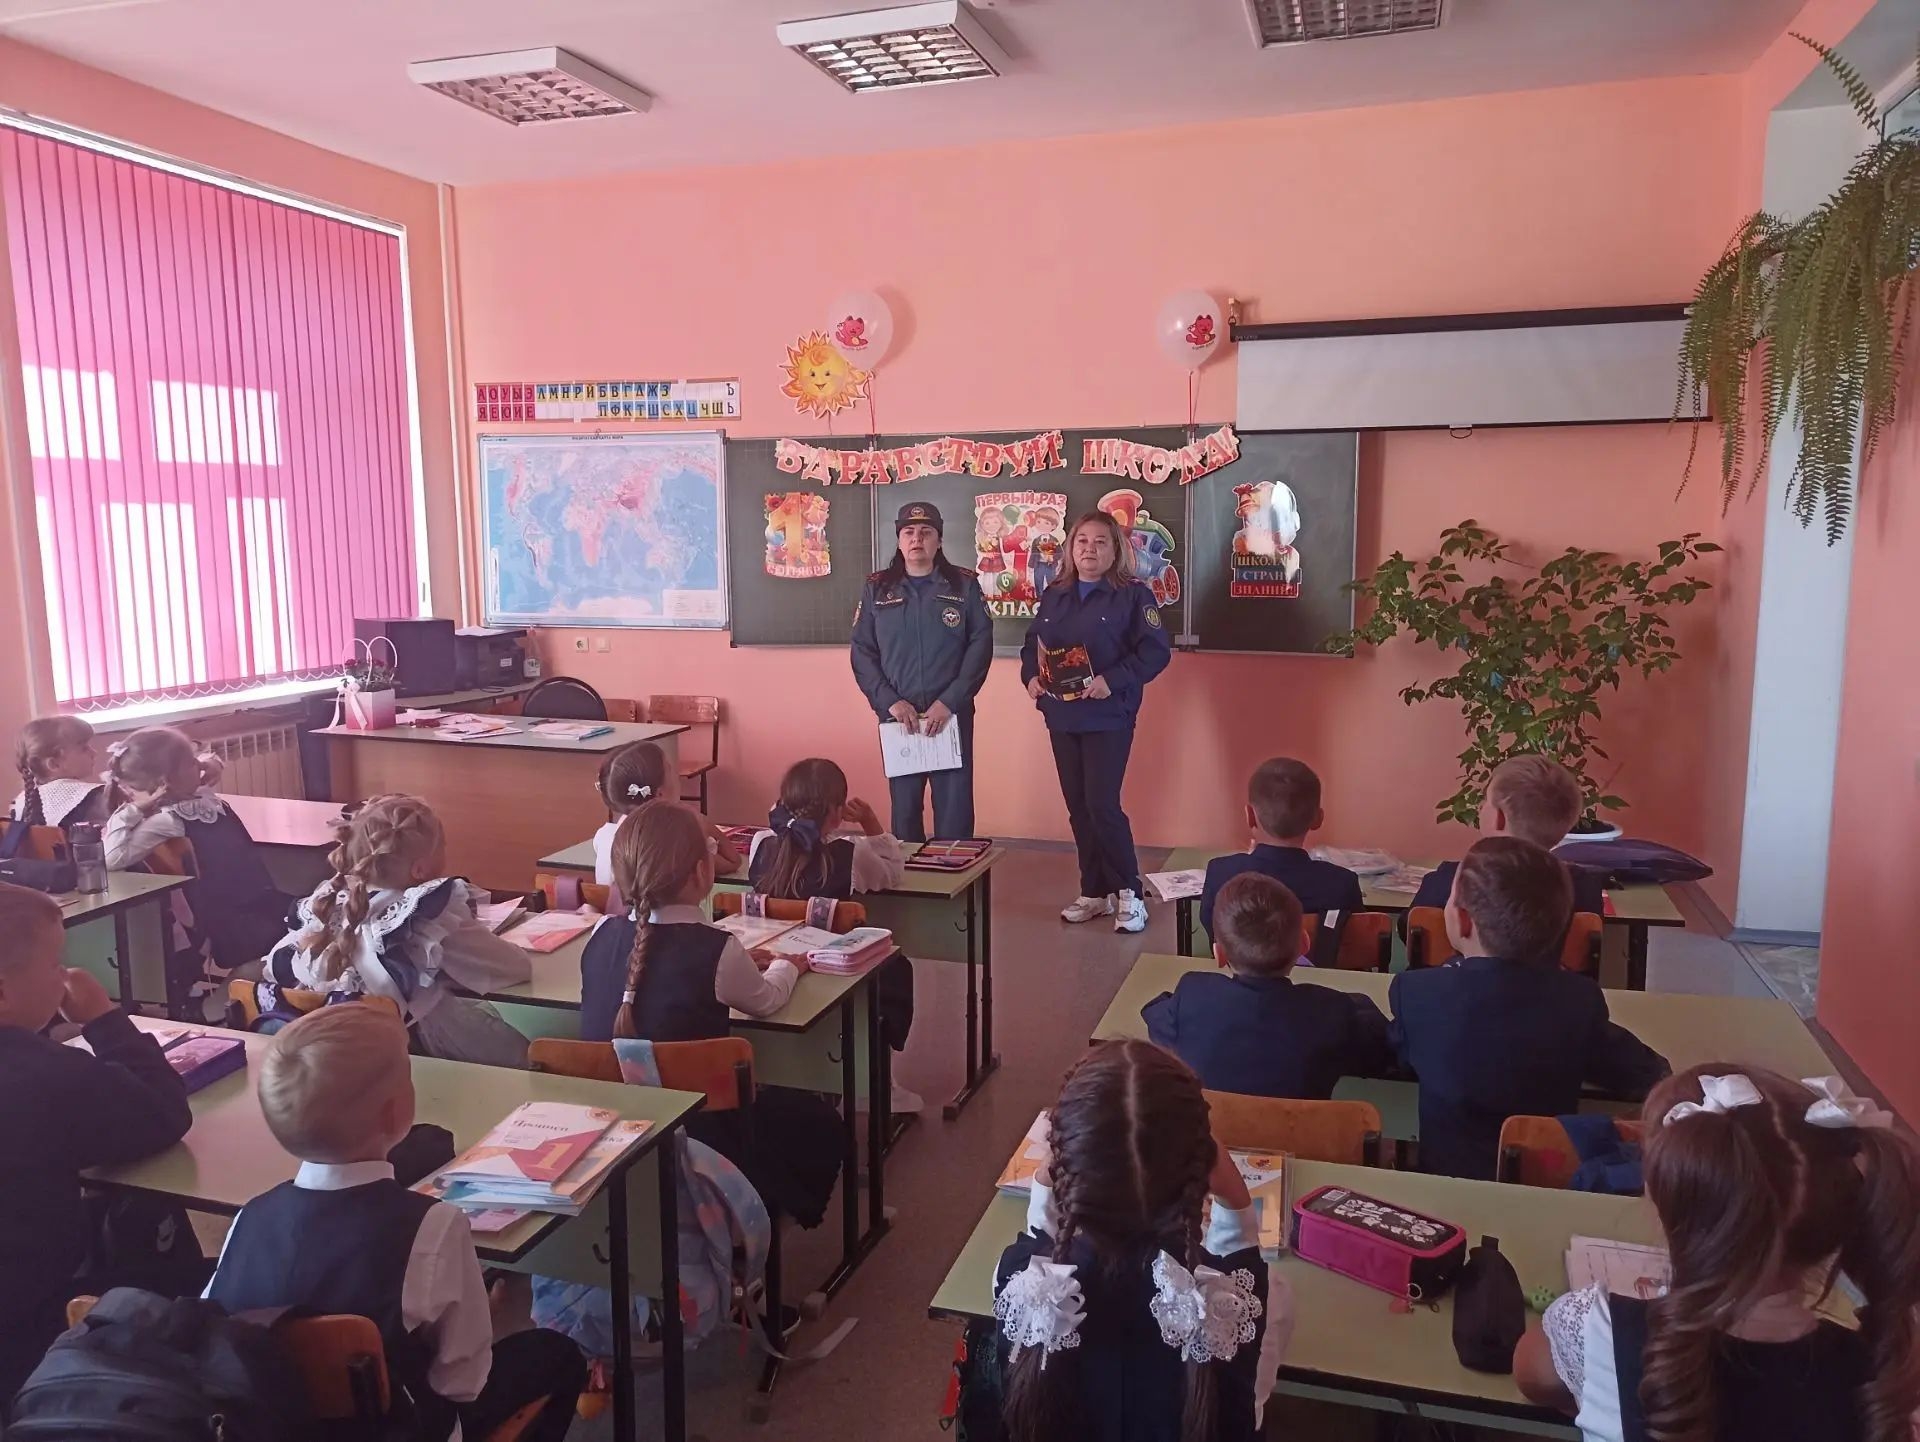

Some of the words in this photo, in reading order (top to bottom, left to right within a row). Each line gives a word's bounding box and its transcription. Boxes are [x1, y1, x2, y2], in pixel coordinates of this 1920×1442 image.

[976, 490, 1035, 507] ПЕРВЫЙ
[1039, 493, 1067, 506] РАЗ
[1242, 570, 1286, 581] СТРАН
[987, 601, 1042, 617] КЛАС
